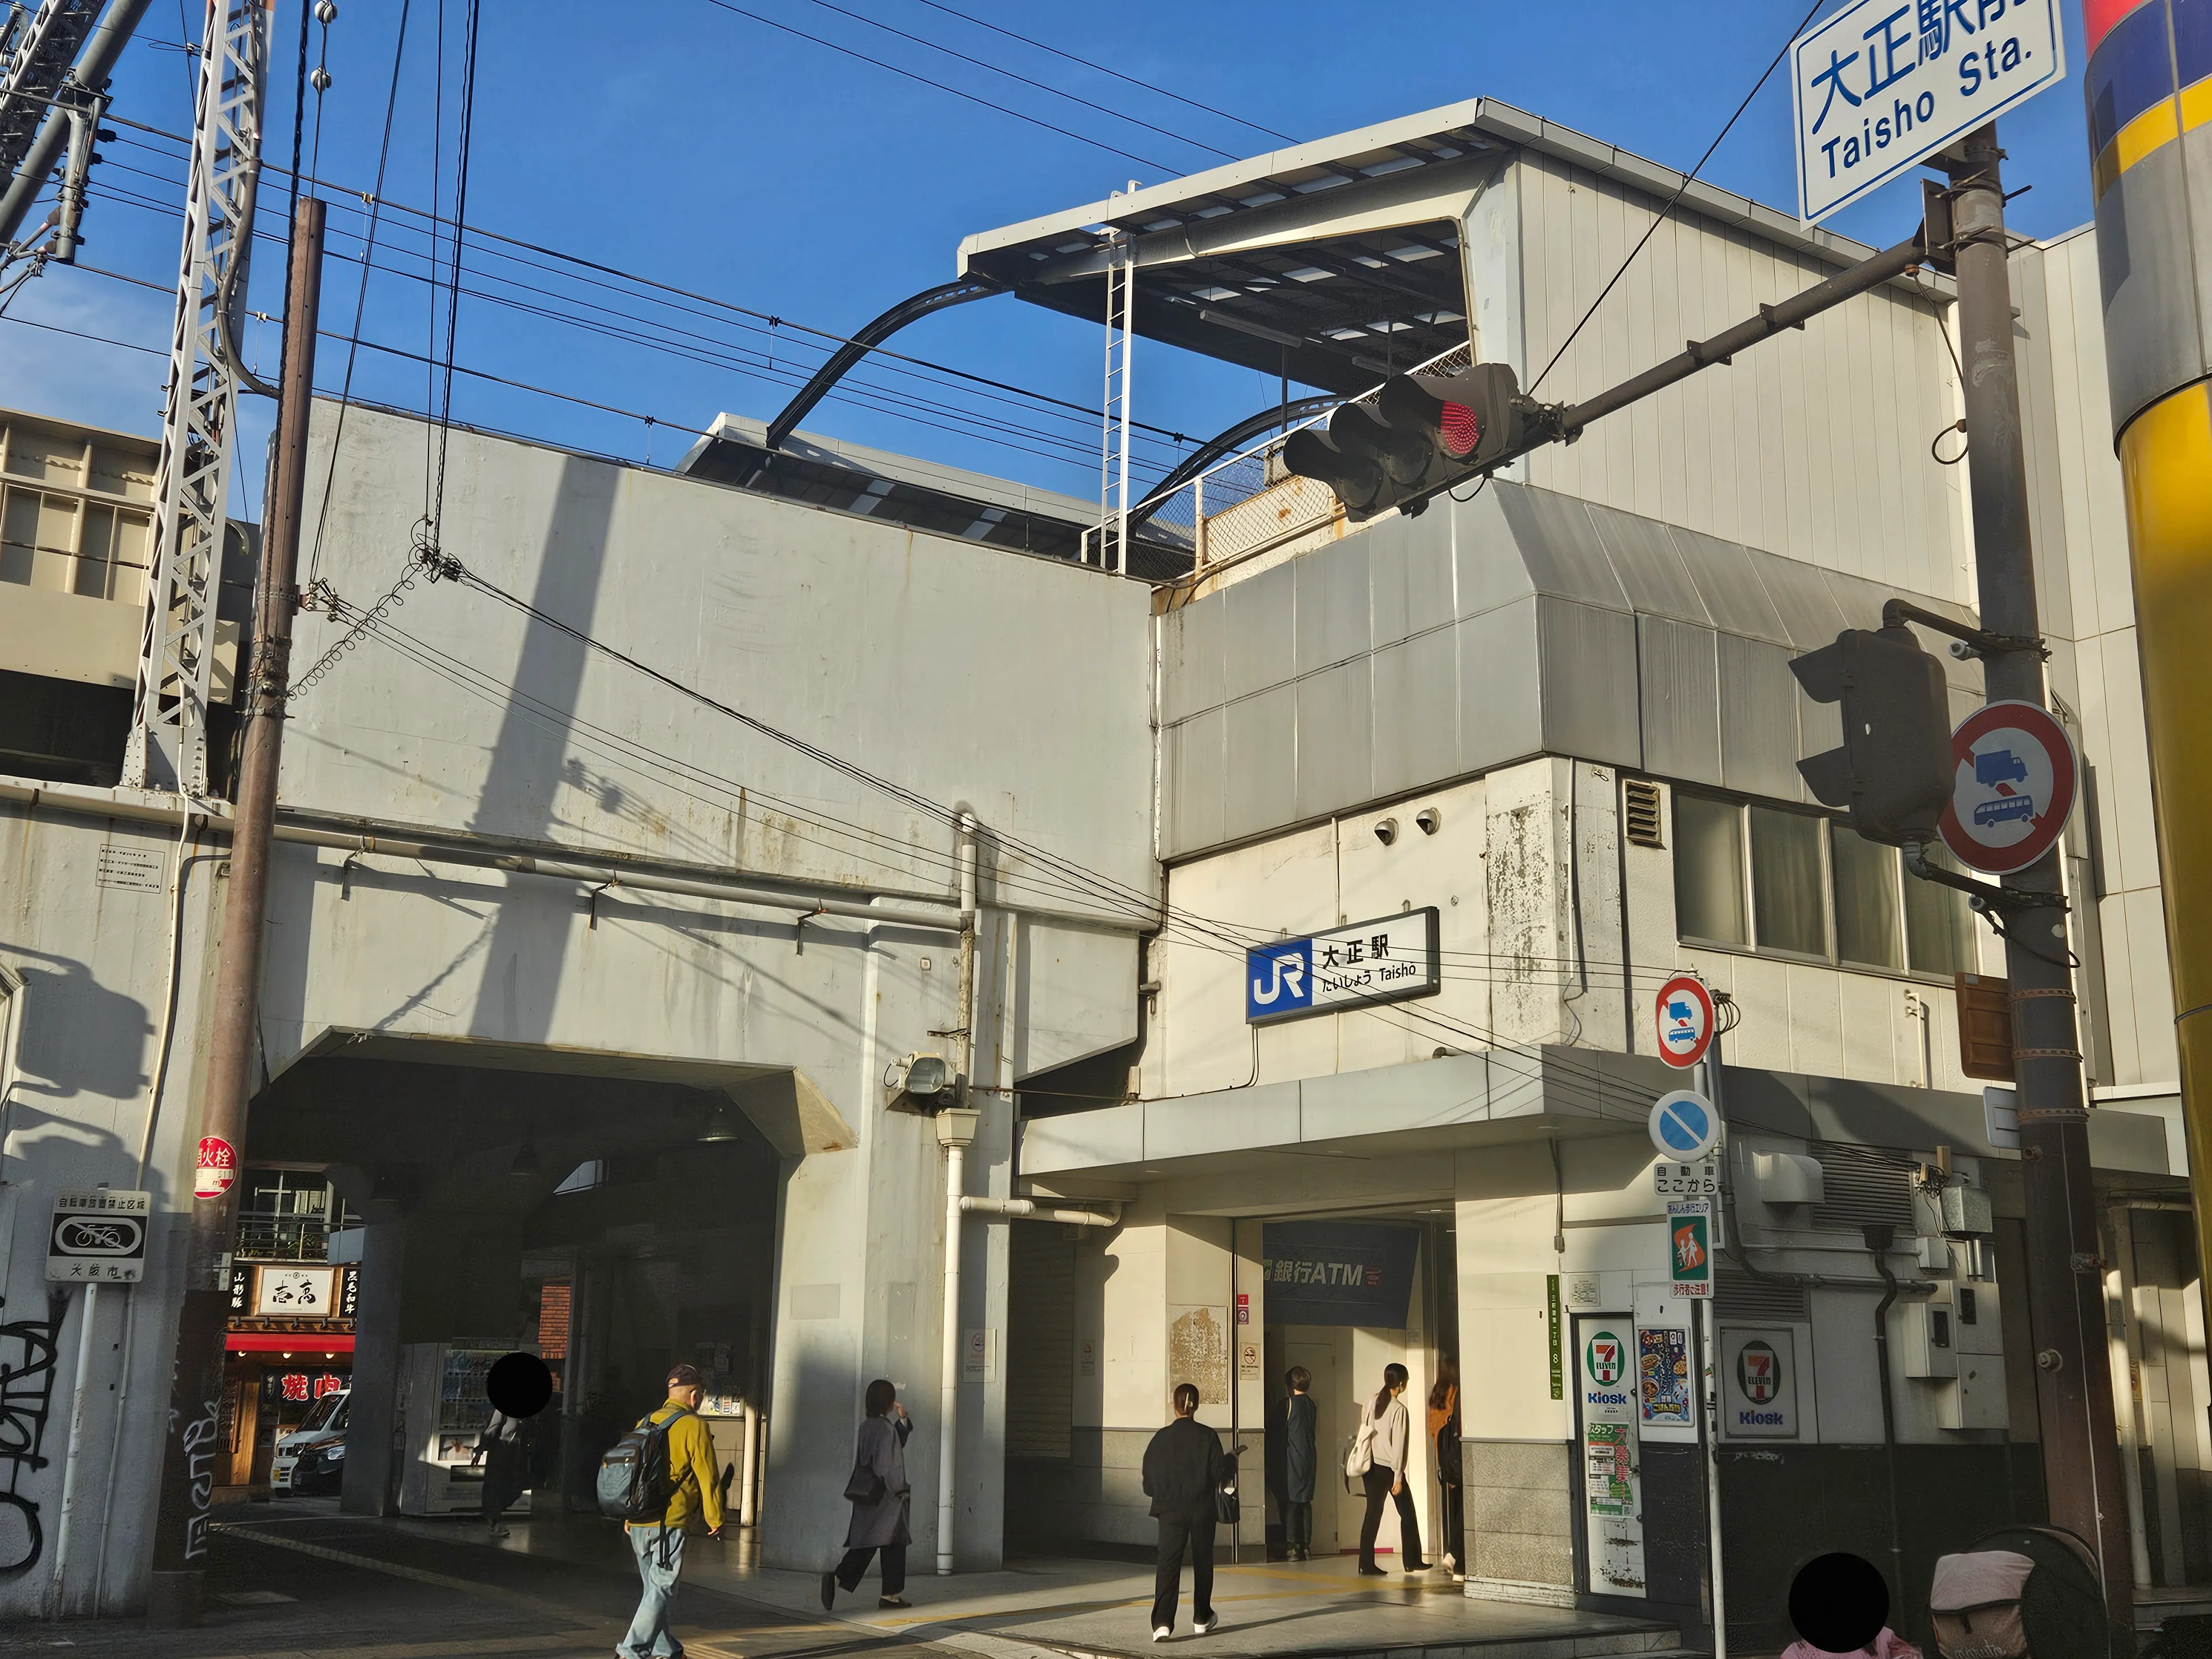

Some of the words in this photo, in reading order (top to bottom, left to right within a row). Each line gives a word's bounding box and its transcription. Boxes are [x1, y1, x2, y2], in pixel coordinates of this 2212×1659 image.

[1821, 91, 1934, 179] Taisho
[1959, 36, 2032, 97] Sta.
[1322, 933, 1389, 969] 大正駅
[1254, 952, 1305, 1005] JR
[1322, 970, 1371, 993] たいしょう
[1657, 1166, 1714, 1176] 自動車
[1657, 1179, 1715, 1192] ここから
[1588, 1391, 1627, 1405] Kiosk
[1740, 1410, 1783, 1425] Kiosk
[1590, 1425, 1614, 1434] スタッフ
